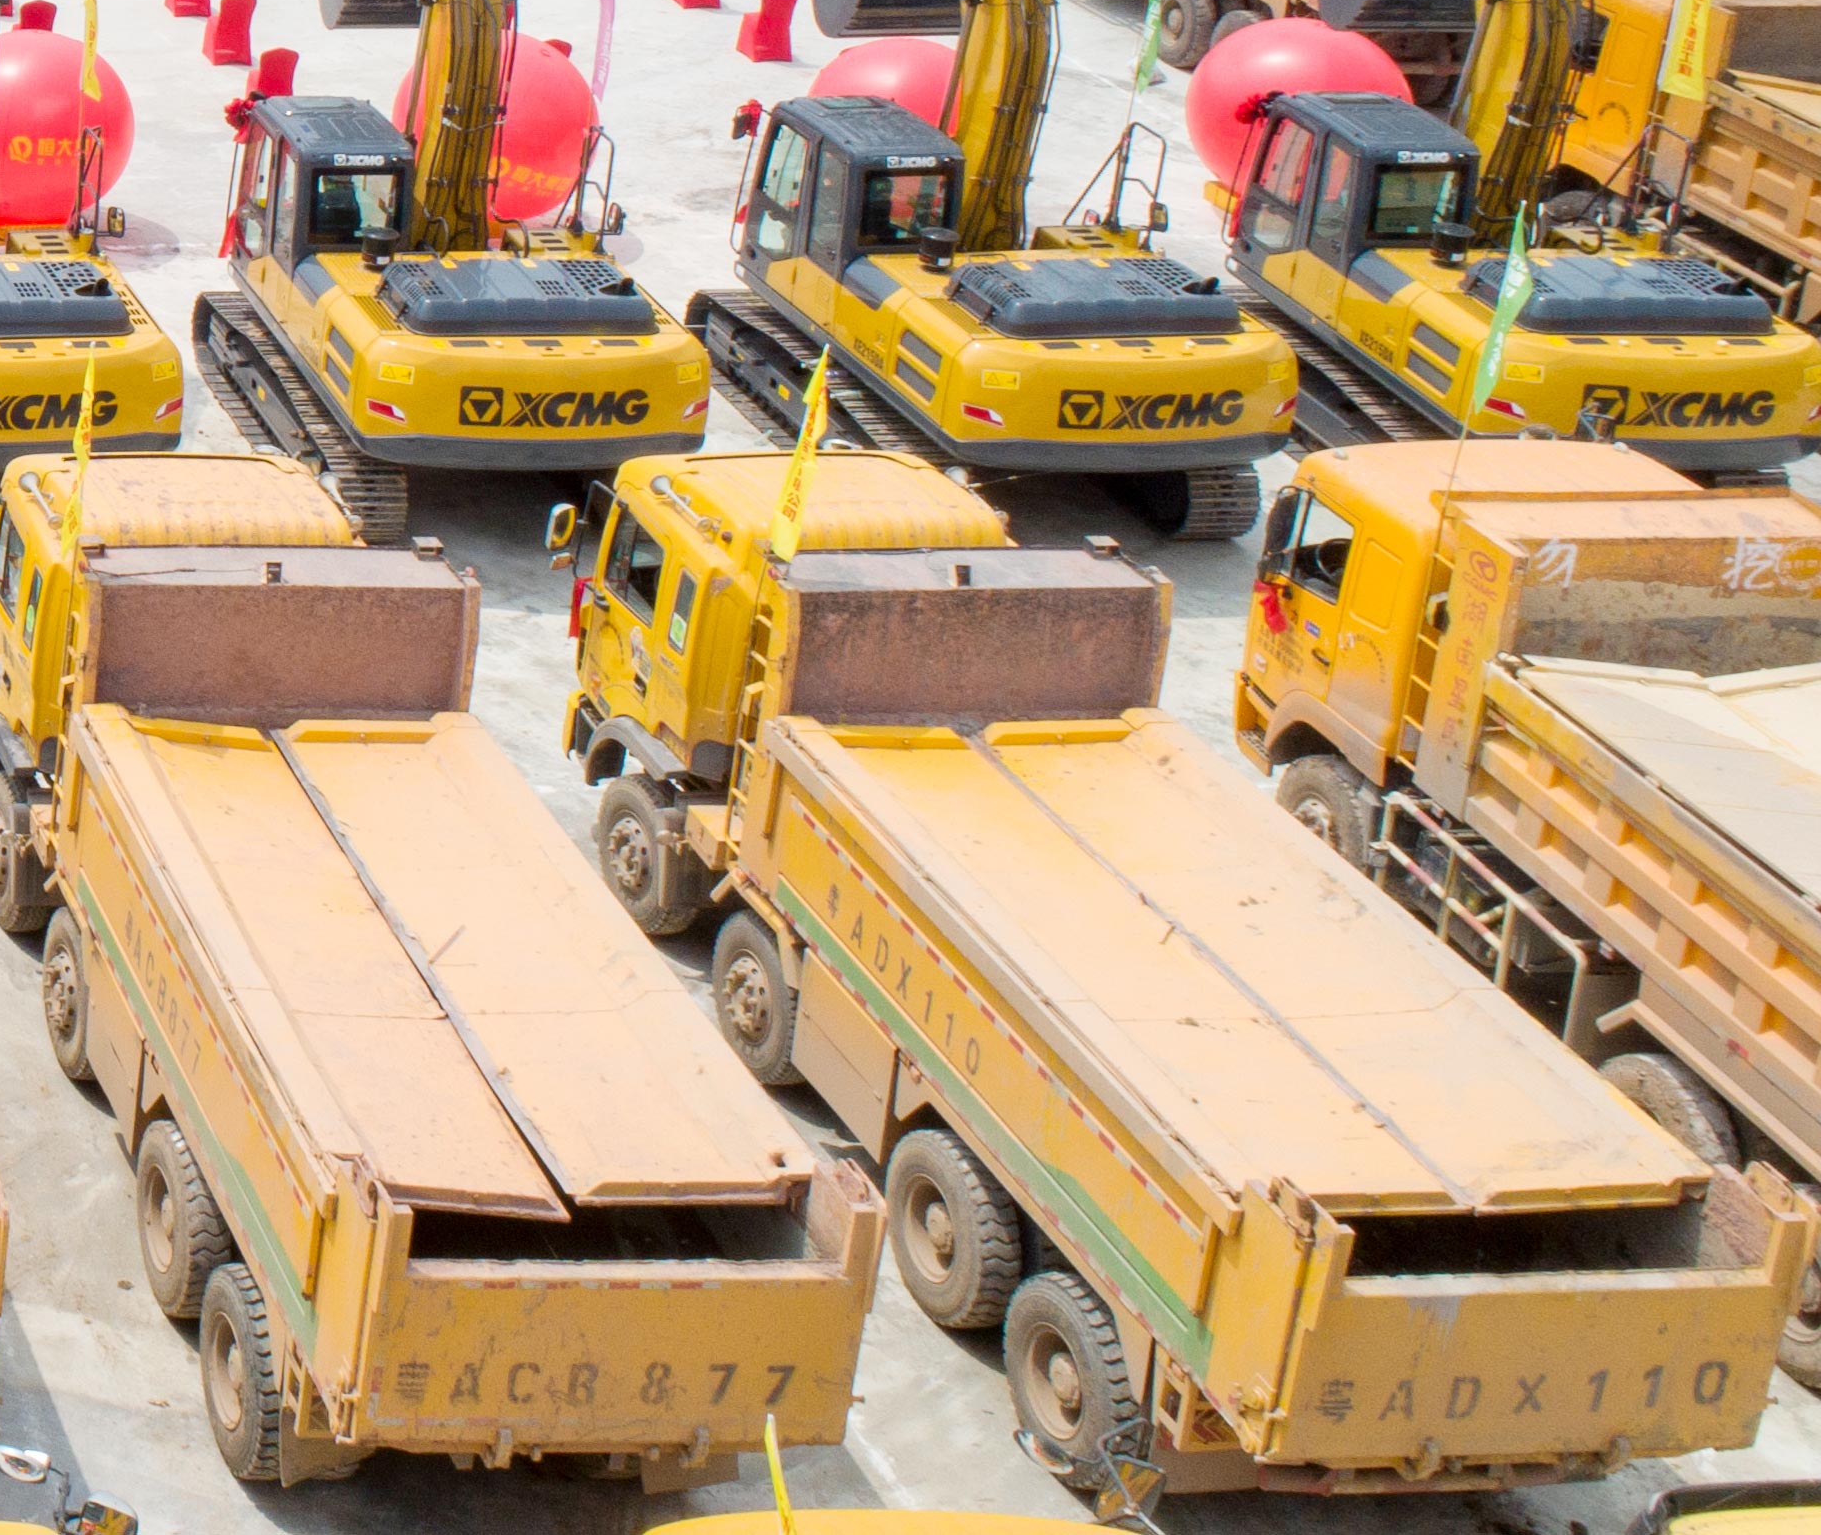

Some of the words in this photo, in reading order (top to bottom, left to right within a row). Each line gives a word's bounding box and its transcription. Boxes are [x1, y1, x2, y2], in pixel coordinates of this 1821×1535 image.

[347, 155, 385, 166] XCMG
[899, 156, 937, 168] XCMG
[1412, 152, 1450, 163] XCMG
[504, 387, 650, 428] XCMG
[1103, 389, 1245, 431] XCMG
[1627, 390, 1777, 428] XCMG
[1321, 1362, 1730, 1425] 粤ADX110
